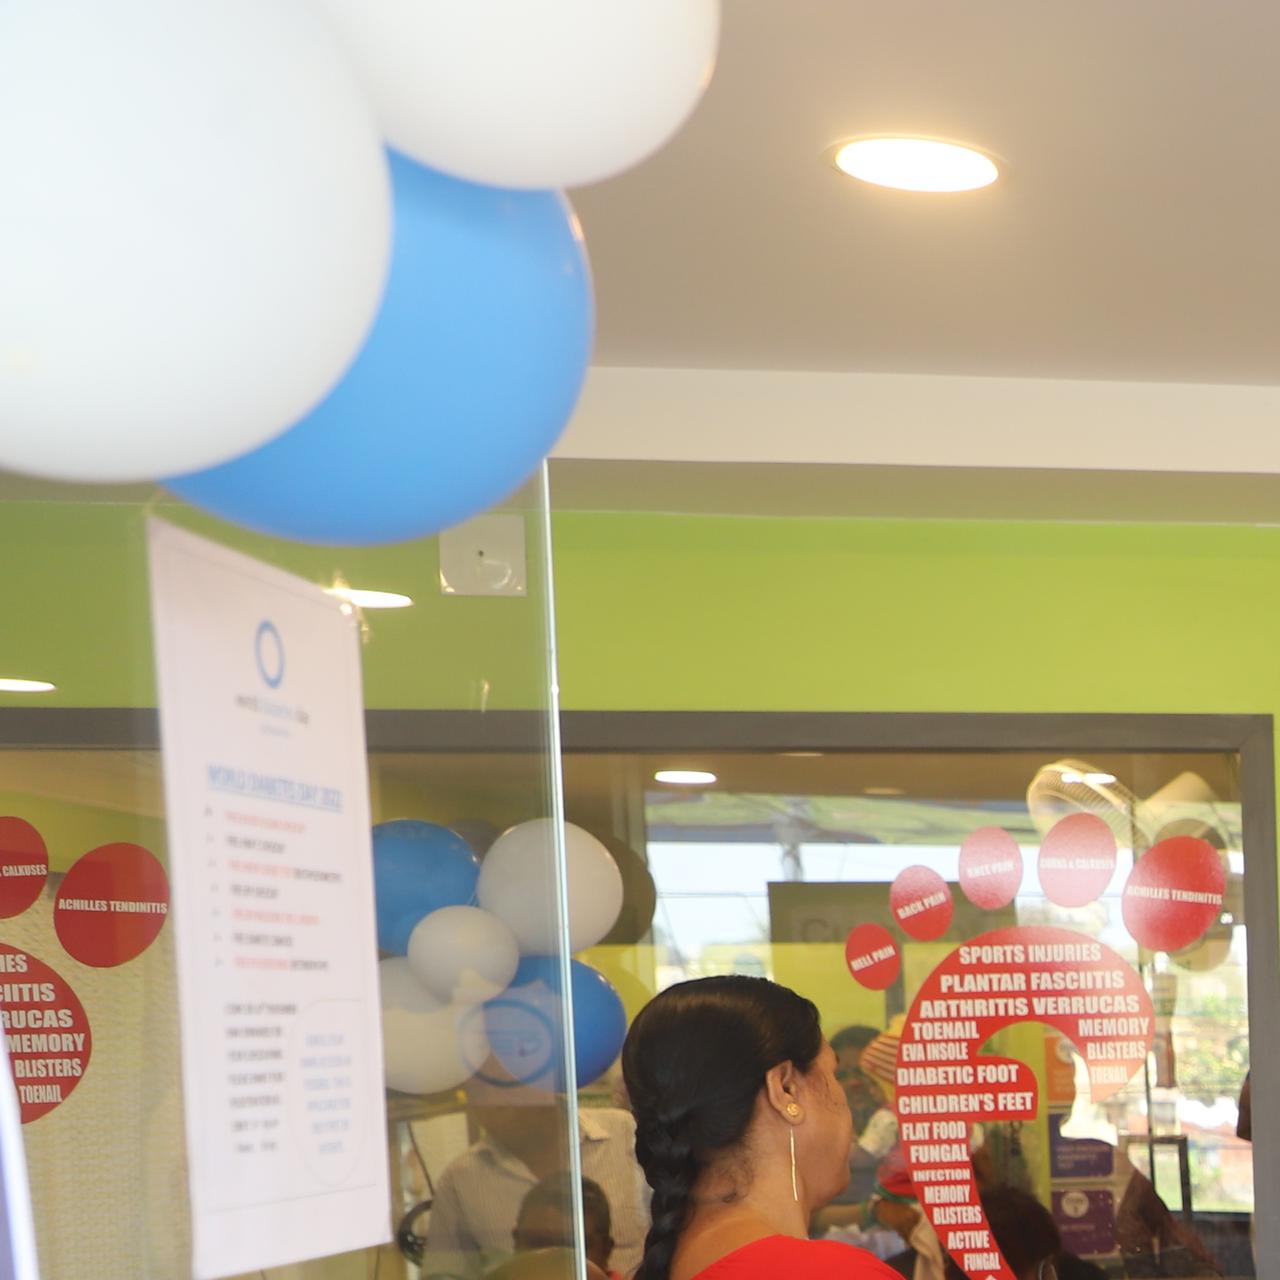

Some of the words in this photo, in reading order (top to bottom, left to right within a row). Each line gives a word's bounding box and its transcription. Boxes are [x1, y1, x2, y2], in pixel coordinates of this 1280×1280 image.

[1127, 885, 1170, 901] ACHILLES
[1172, 889, 1223, 905] TENDINITIS
[59, 898, 107, 911] ACHILLES
[110, 901, 168, 914] TENDINITIS
[897, 901, 924, 920] BACK
[924, 891, 946, 910] PAIN
[873, 944, 896, 963] PAIN
[959, 945, 1025, 965] SPORTS
[1028, 944, 1102, 963] INJURIES
[940, 973, 1026, 993] PLANTAR
[1031, 971, 1125, 991] FASCIITIS
[919, 998, 1029, 1019] ARTHRITIS
[1032, 995, 1140, 1016] VERRUCAS
[912, 1022, 980, 1040] TOENAIL
[1078, 1017, 1149, 1037] MEMORY
[7, 1033, 85, 1053] MEMORY
[902, 1043, 925, 1061] EVA
[927, 1042, 968, 1061] INSOLE
[1087, 1041, 1146, 1060] BLISTERS
[15, 1058, 82, 1078] BLISTERS
[897, 1065, 974, 1086] DIABETIC
[977, 1064, 1019, 1083] FOOT
[1091, 1066, 1128, 1084] TOENAIL
[19, 1084, 62, 1104] TOENAIL
[898, 1093, 995, 1114] CHILDREN'S
[998, 1092, 1033, 1112] FEET
[902, 1122, 931, 1141] FLAT
[932, 1121, 966, 1140] FOOD
[910, 1144, 970, 1163] FUNGAL
[913, 1168, 971, 1182] INFECTION
[924, 1184, 971, 1204] MEMORY
[932, 1205, 982, 1225] BLISTERS
[947, 1230, 989, 1250] ACTIVE
[963, 1252, 1001, 1272] FUNGAL
